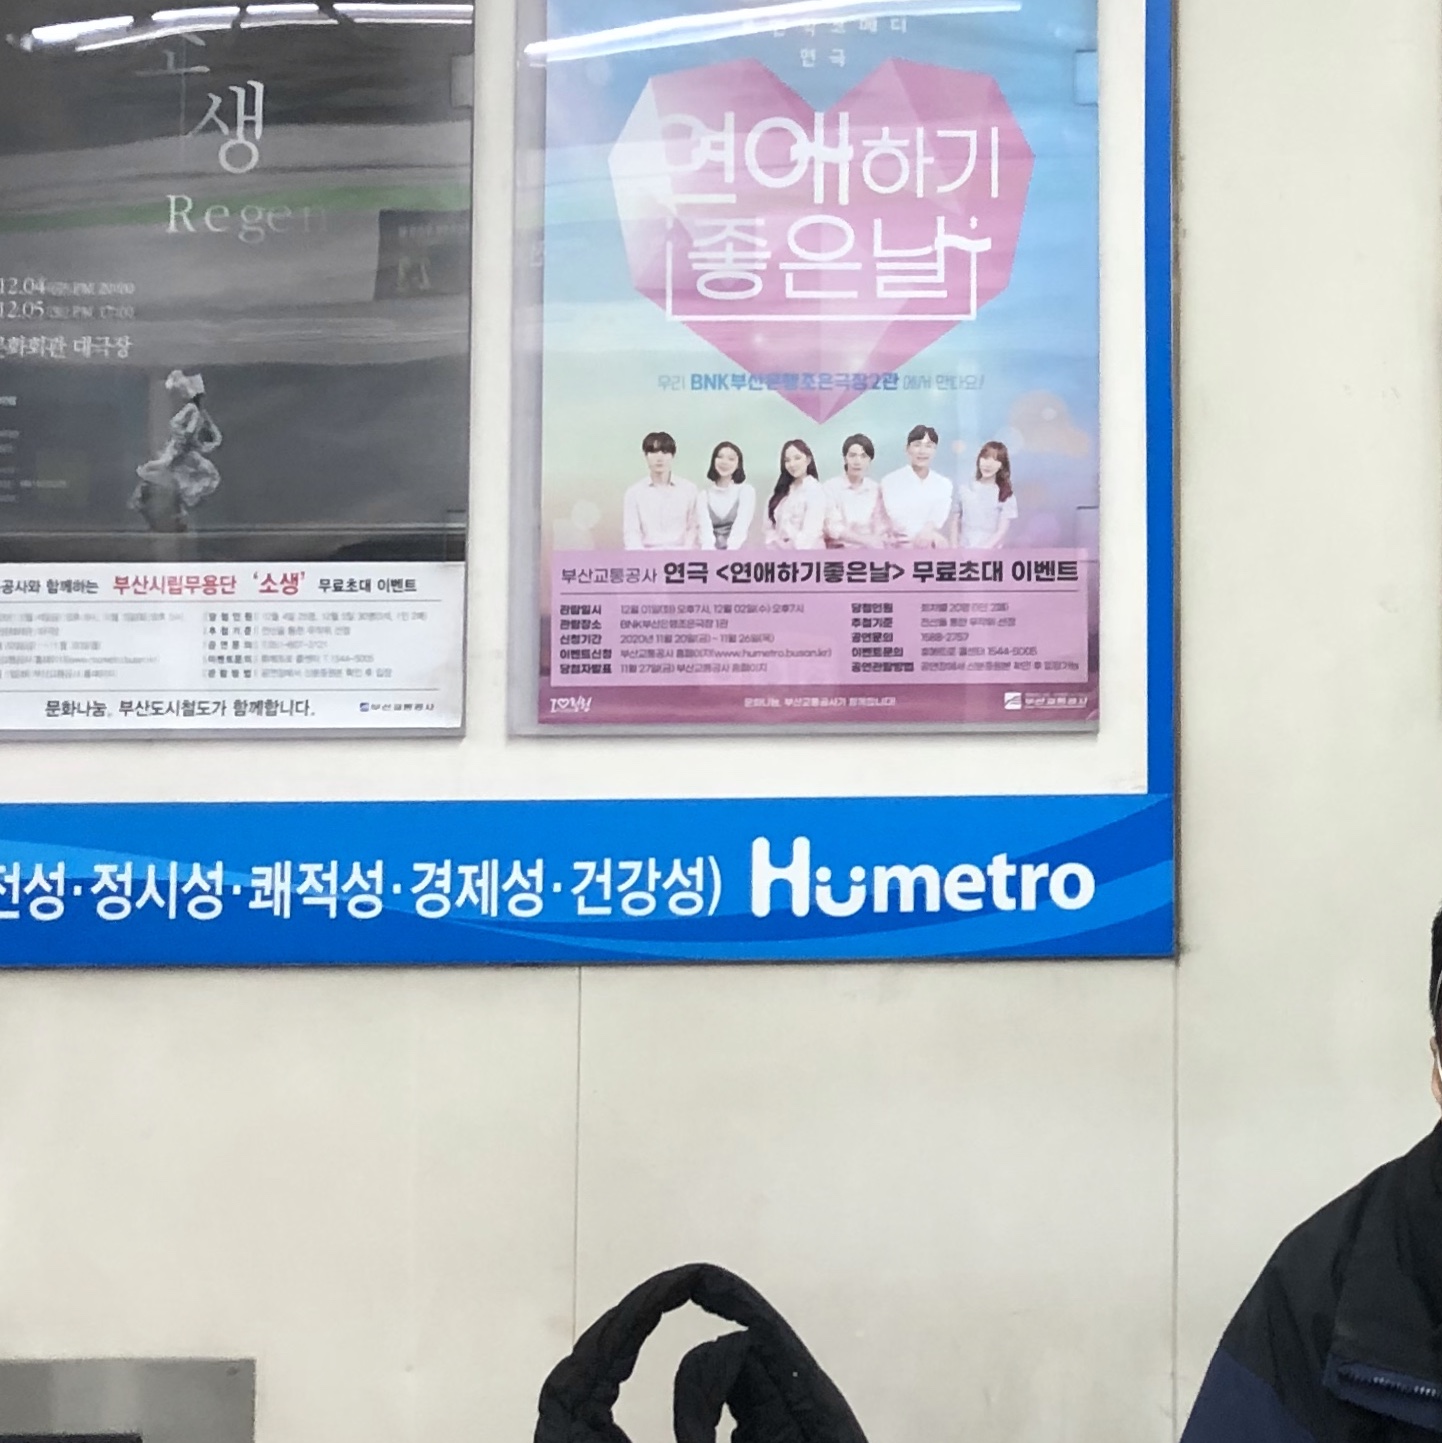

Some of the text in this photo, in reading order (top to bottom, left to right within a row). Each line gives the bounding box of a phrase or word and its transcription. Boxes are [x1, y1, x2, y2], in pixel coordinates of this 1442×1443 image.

[660, 111, 999, 206] 연애하기
[687, 213, 992, 300] 좋은날
[561, 560, 1078, 585] 부산교통공사 연극 <연애하기좋은날> 무료초대 이벤트
[0, 579, 41, 594] 공사와
[46, 578, 99, 594] 함께하는
[113, 574, 237, 595] 부산시립무용단
[318, 578, 371, 593] 무료초대
[377, 578, 417, 593] 이벤트
[559, 634, 602, 645] 신청기간
[119, 700, 226, 718] 부산도시철도가
[233, 699, 316, 717] 함께합니다.
